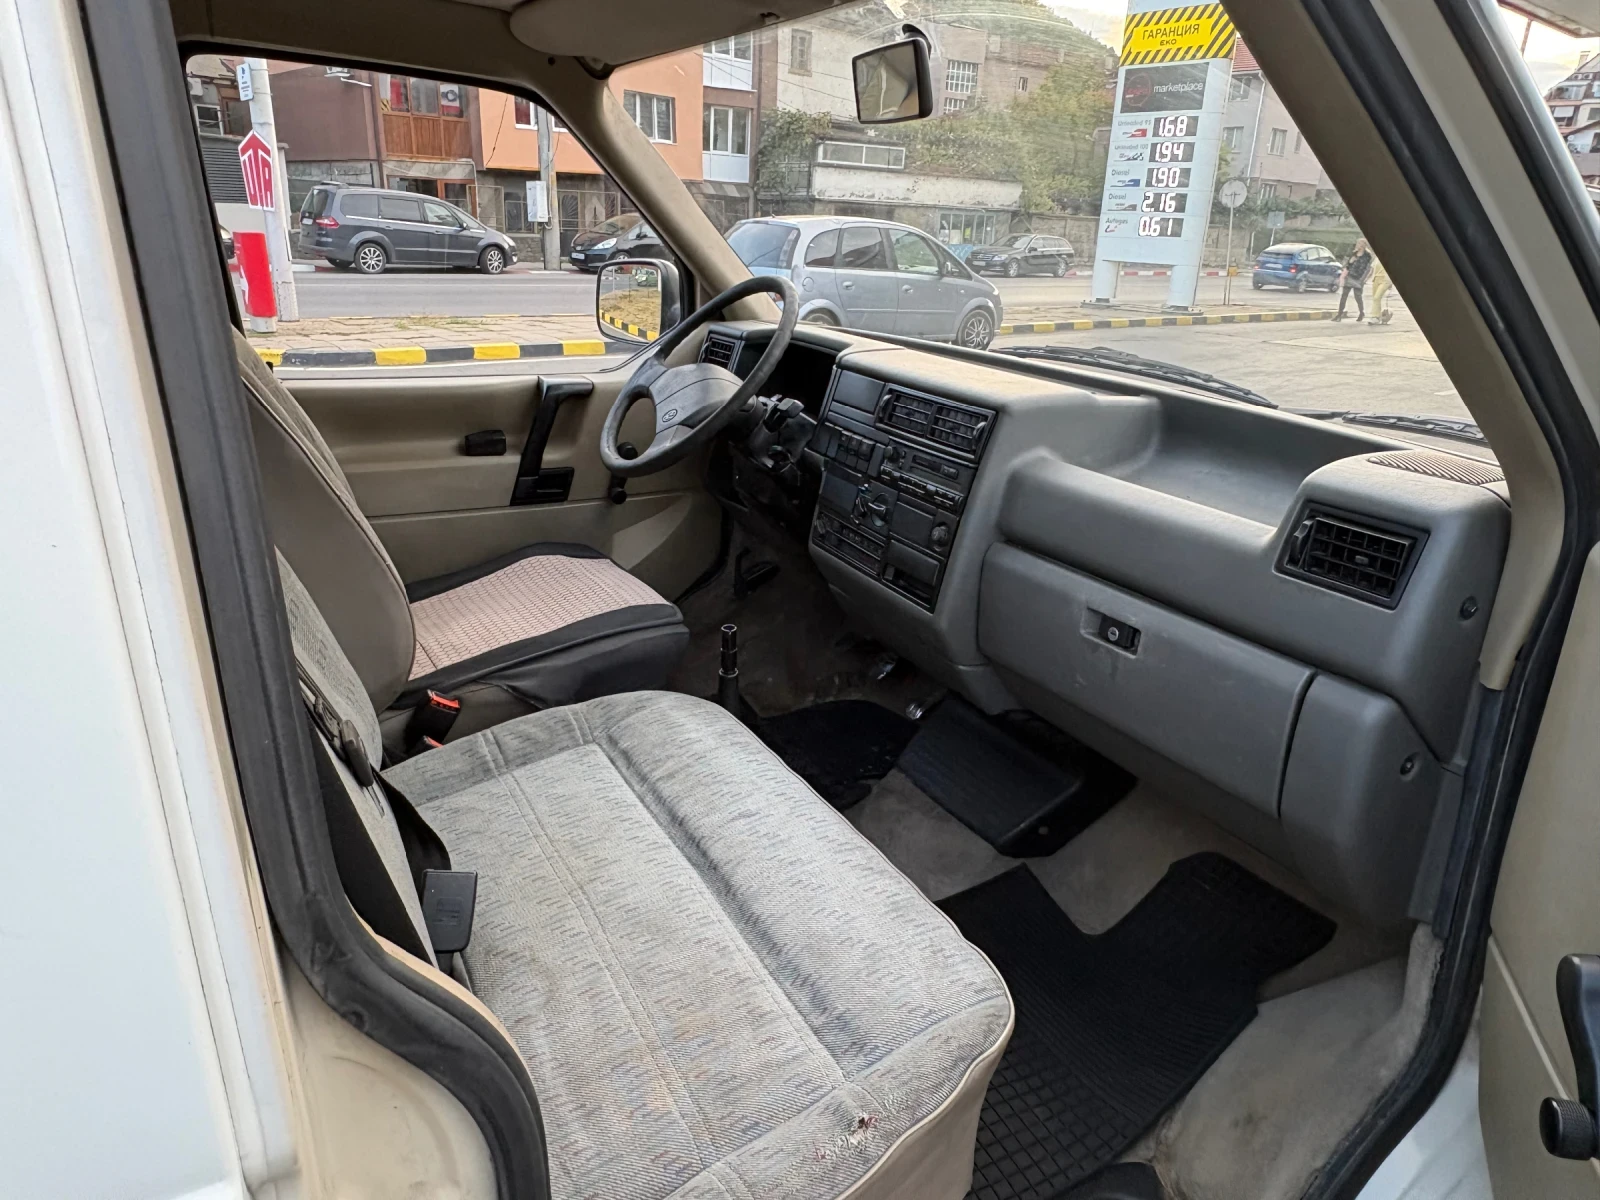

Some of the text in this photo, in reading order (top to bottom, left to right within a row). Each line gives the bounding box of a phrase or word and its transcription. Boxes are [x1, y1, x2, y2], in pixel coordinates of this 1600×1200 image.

[1142, 23, 1200, 40] ГАРАНЦИЯ
[1153, 81, 1204, 93] marketplace
[1105, 217, 1129, 226] Autogas
